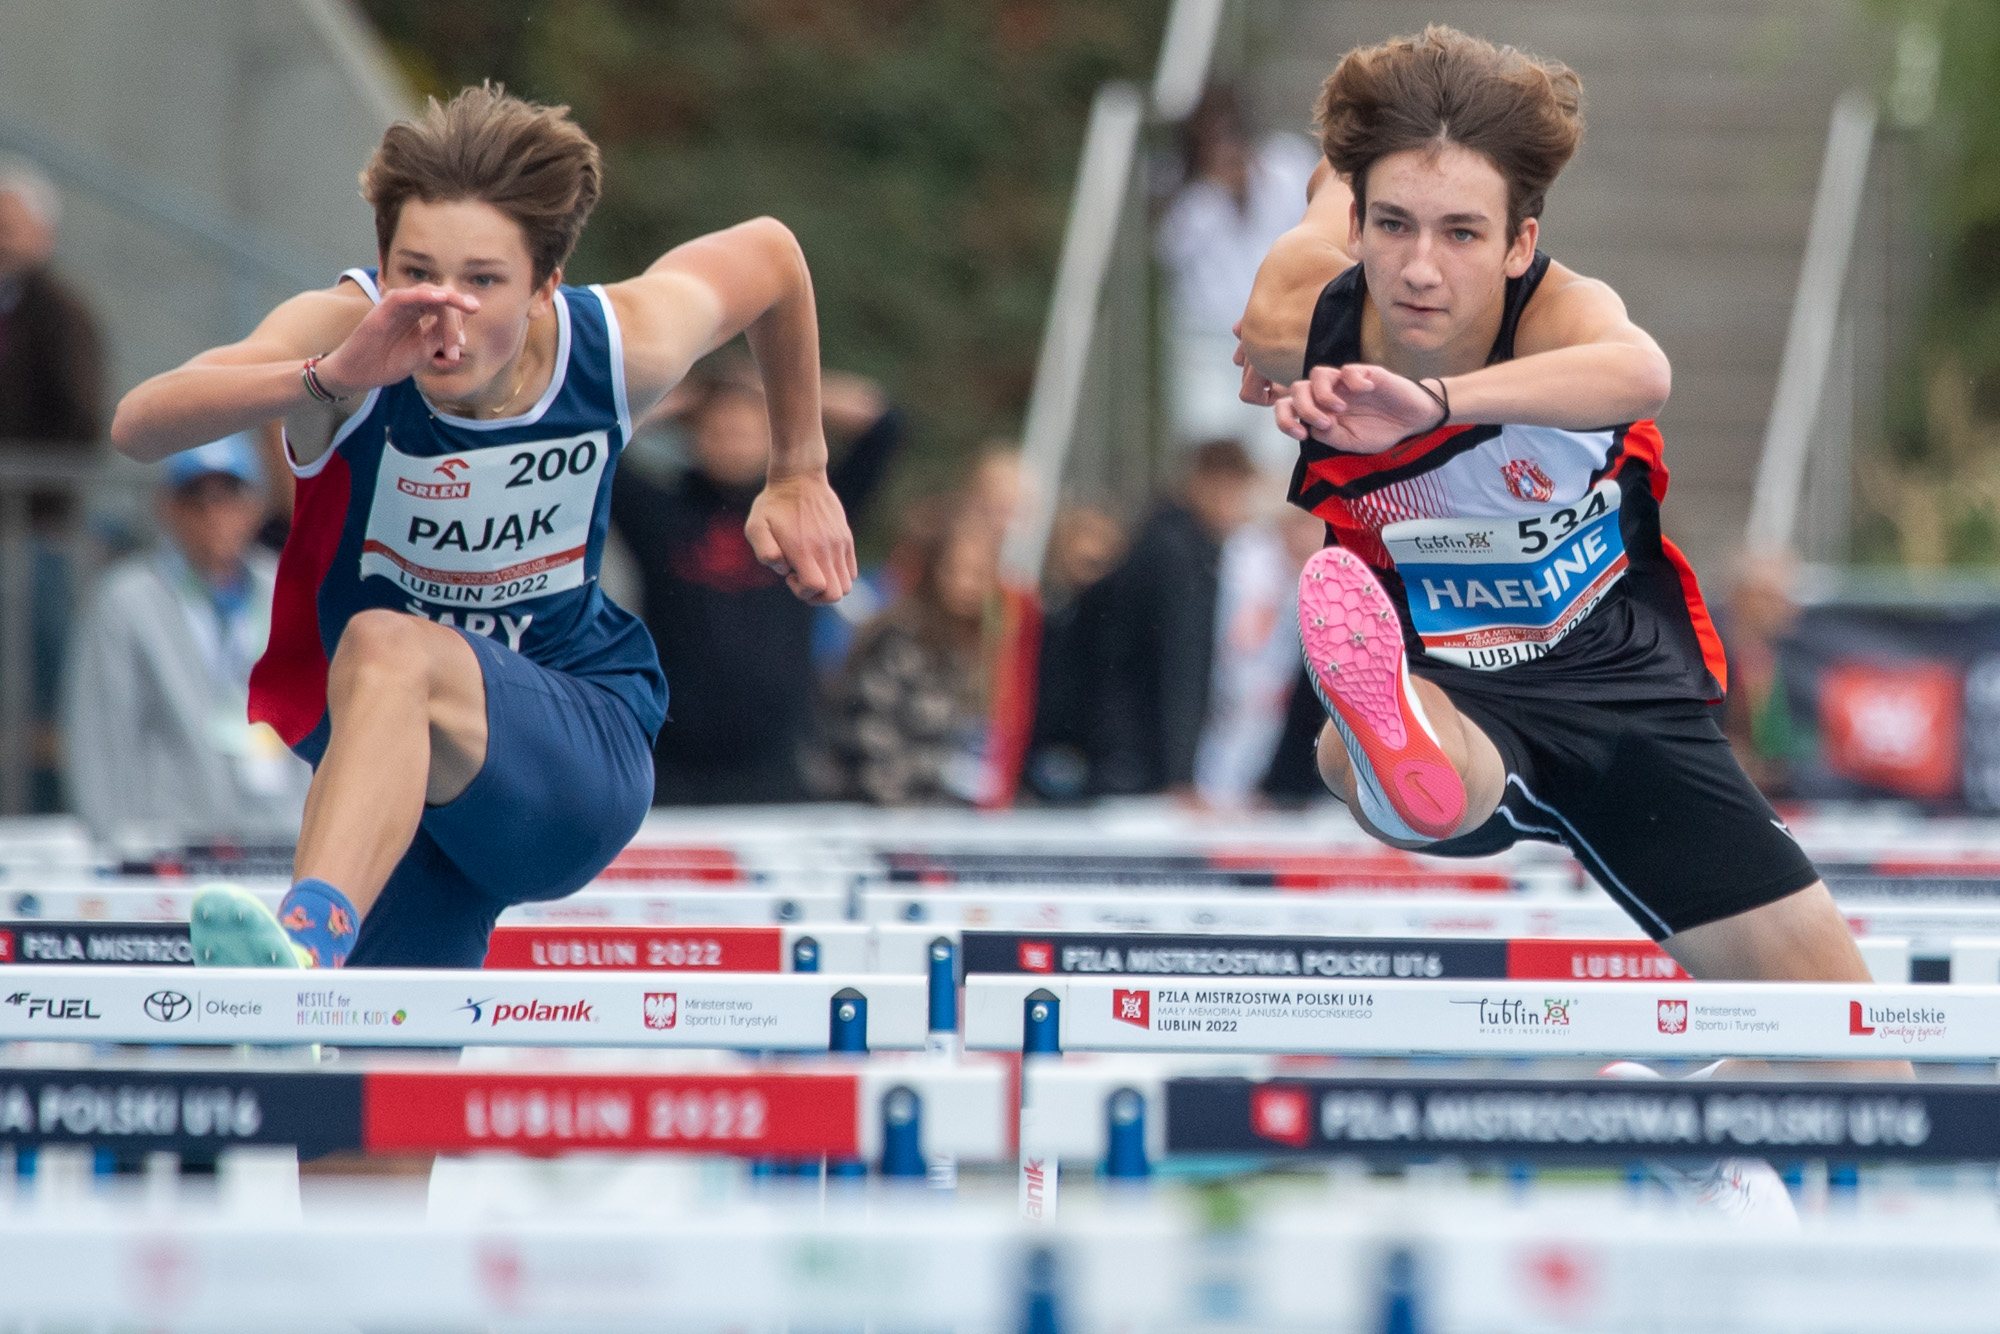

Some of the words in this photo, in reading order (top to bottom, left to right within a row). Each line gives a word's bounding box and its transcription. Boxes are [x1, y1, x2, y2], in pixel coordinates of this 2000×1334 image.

[505, 440, 597, 489] 200
[400, 481, 466, 497] ORLEN
[407, 503, 561, 552] PAJĄK
[1518, 492, 1609, 553] 534
[1421, 525, 1608, 611] HAEHNE
[400, 571, 483, 602] LUBLIN
[491, 574, 548, 601] 2022
[1468, 643, 1549, 668] LUBLIN
[87, 935, 192, 962] MISTRZO
[531, 940, 637, 966] LUBLIN
[648, 939, 722, 966] 2022
[1062, 946, 1124, 972] PZLA
[1302, 950, 1390, 976] POLSKI
[1393, 951, 1443, 977] U16
[1571, 953, 1677, 978] LUBLIN
[337, 995, 350, 1007] for
[685, 999, 752, 1011] Ministerstwo
[1158, 991, 1190, 1003] PZLA
[1195, 991, 1291, 1005] MISTRZOSTWA
[1297, 993, 1344, 1006] POLSKI
[1349, 993, 1374, 1006] U16
[28, 999, 101, 1019] FUEL
[205, 1000, 262, 1018] Okęcie
[297, 1009, 358, 1025] HEALTHIER
[363, 1009, 389, 1025] KIDS
[491, 998, 594, 1027] polanik
[1157, 1007, 1186, 1017] MAŁY
[1189, 1007, 1242, 1017] MEMORIAŁ
[1245, 1008, 1289, 1018] JANUSZA
[1292, 1006, 1373, 1019] KUSOCIŃSKIEGO
[1449, 998, 1539, 1025] lublin
[1694, 1006, 1757, 1017] Ministerstwo
[1869, 1007, 1945, 1024] lubelskie
[684, 1014, 721, 1027] Sportu
[728, 1014, 777, 1027] Turystyki
[1157, 1020, 1202, 1032] LUBLIN
[1206, 1020, 1238, 1033] 2022
[1694, 1020, 1727, 1032] Sportu
[1735, 1020, 1779, 1033] Turystyki
[1518, 1028, 1570, 1036] INSPIRACJI
[464, 1088, 633, 1140] LUBLIN
[647, 1088, 768, 1140] 2022
